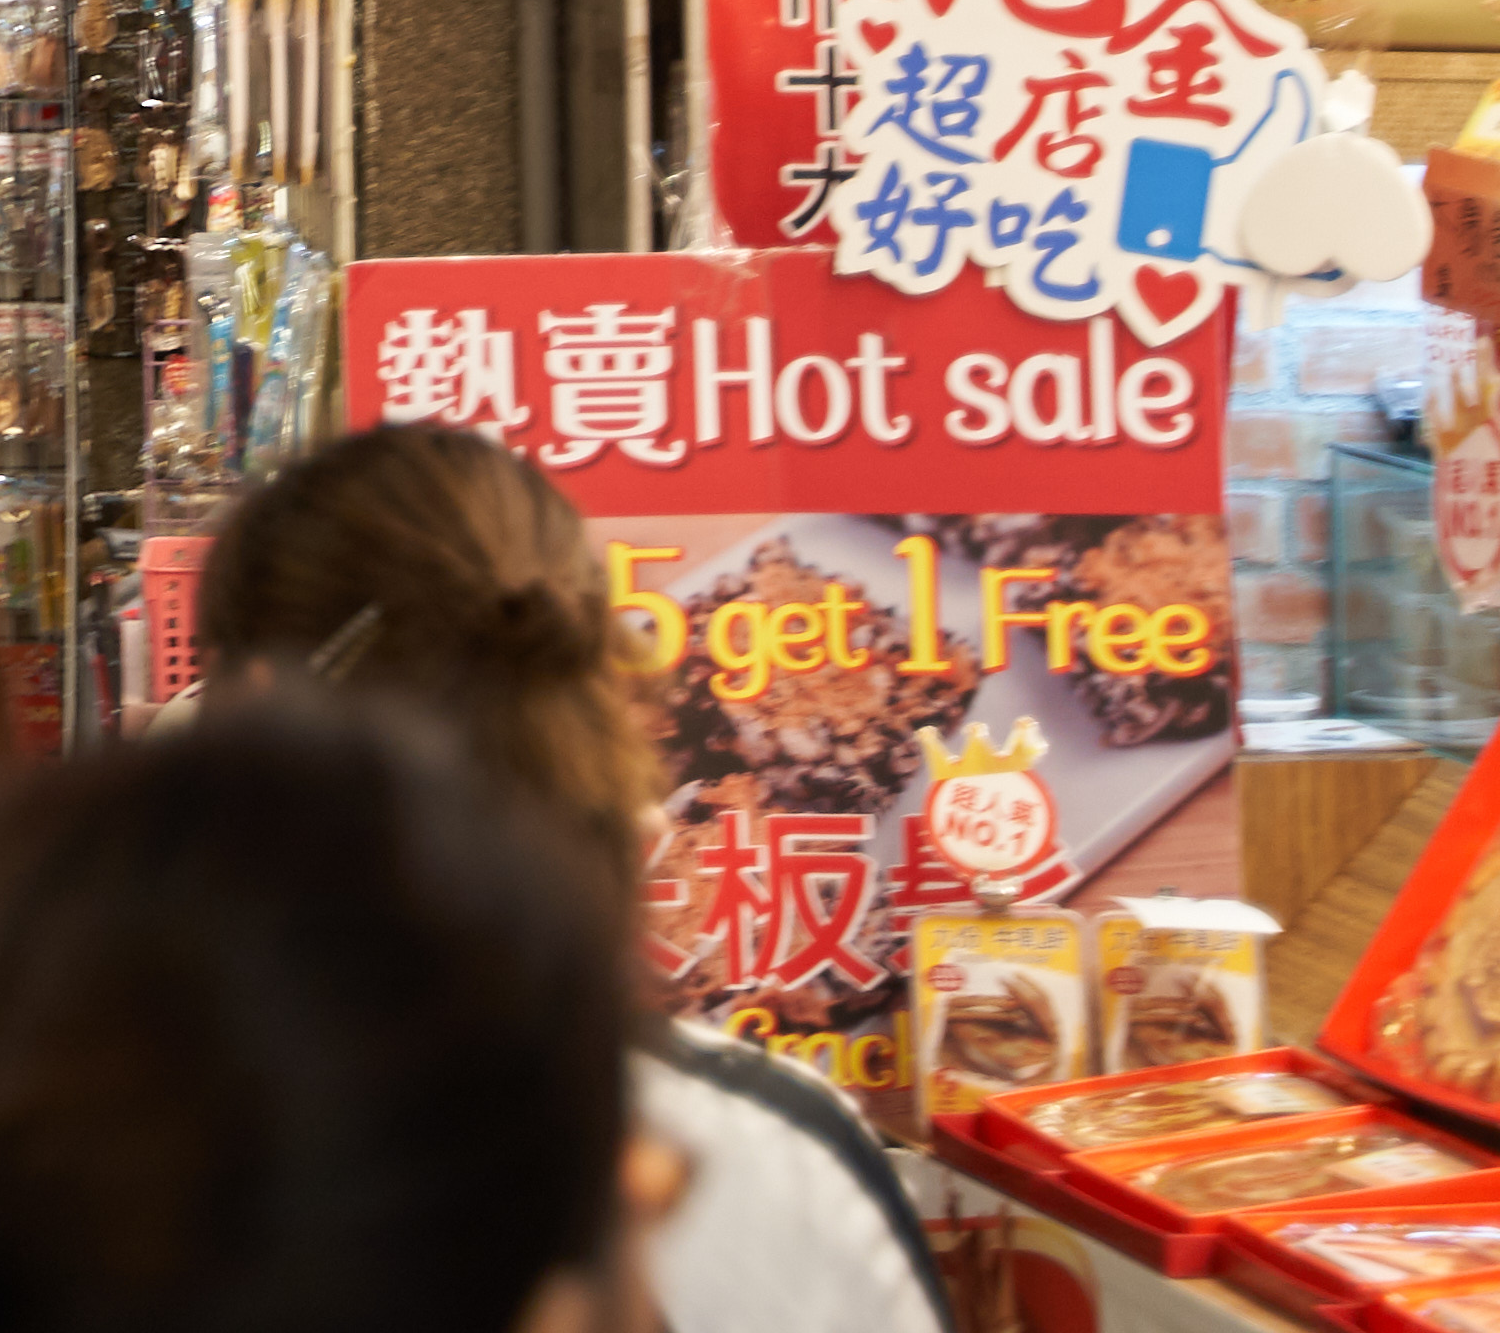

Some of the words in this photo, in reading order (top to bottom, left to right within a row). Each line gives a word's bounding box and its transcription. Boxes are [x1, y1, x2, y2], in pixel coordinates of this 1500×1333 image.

[866, 41, 991, 165] 超
[853, 163, 1101, 301] 好吃
[692, 317, 910, 447] Hot
[943, 317, 1196, 447] sale
[610, 540, 690, 676] 5
[706, 578, 869, 703] get
[893, 535, 951, 675] 1
[981, 565, 1212, 677] Free
